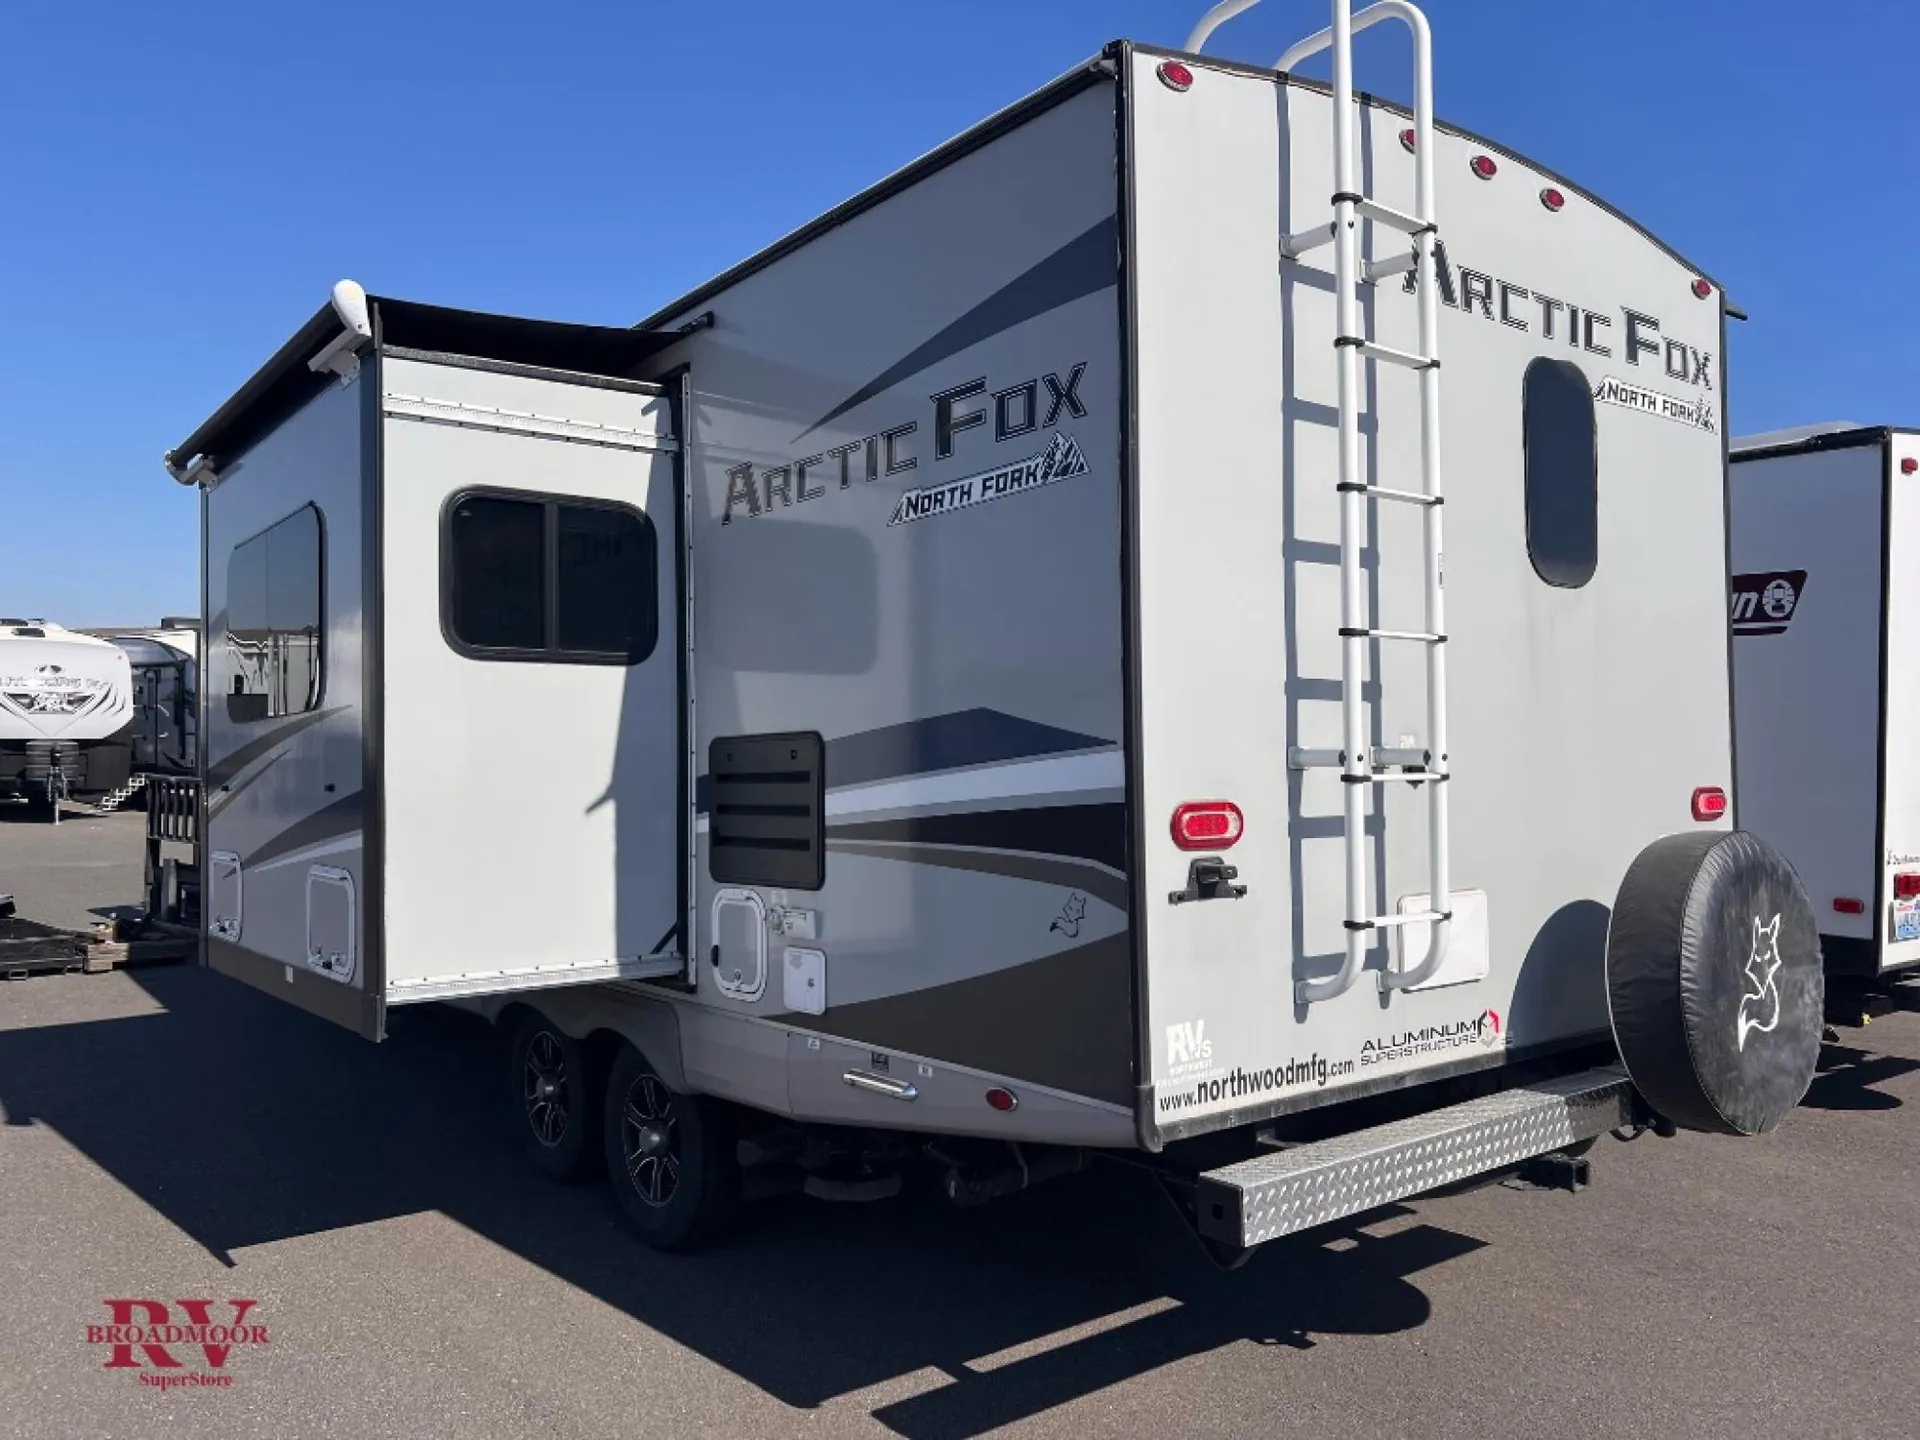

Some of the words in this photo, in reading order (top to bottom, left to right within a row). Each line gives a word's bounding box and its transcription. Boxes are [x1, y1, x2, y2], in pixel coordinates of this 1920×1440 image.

[1620, 305, 1713, 390] FOX
[1606, 381, 1658, 412] NORTH
[1662, 399, 1695, 424] FORK
[721, 420, 918, 528] ARCTIC
[929, 361, 1088, 461] FOX
[904, 481, 974, 518] NORTH
[980, 461, 1040, 499] FORK
[1361, 1018, 1477, 1055] ALUMINUM
[1160, 1051, 1355, 1113] www.northwoodmfg.com
